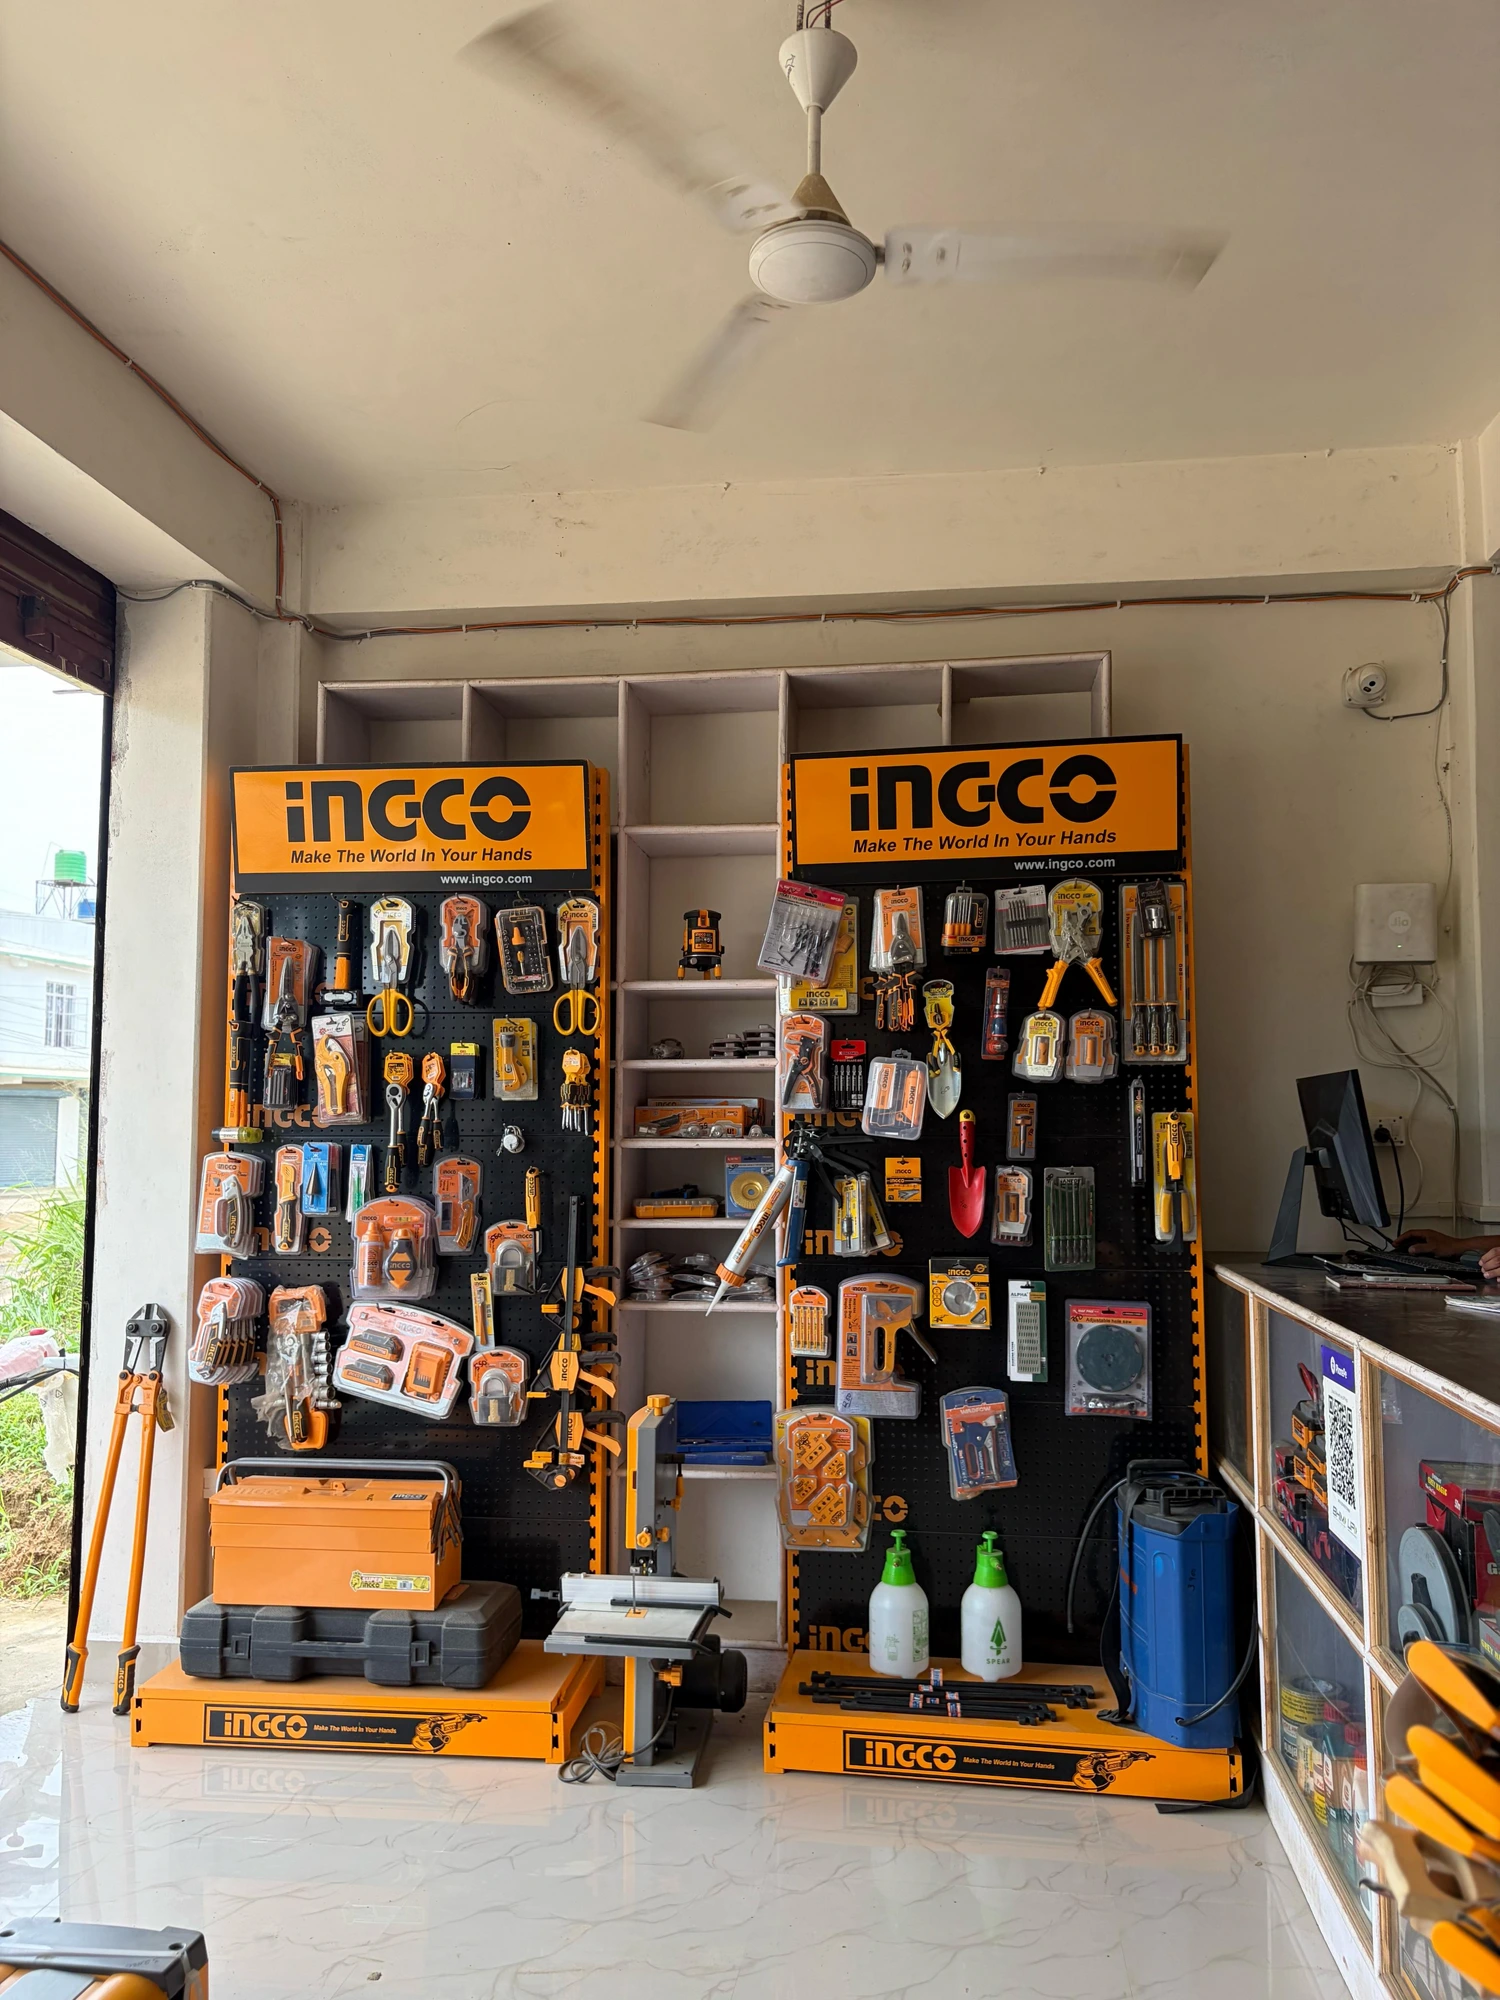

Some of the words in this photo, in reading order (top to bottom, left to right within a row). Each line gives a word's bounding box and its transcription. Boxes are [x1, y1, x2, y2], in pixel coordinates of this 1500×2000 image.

[850, 754, 1117, 831] INGCO
[286, 776, 531, 842] INGCO
[853, 838, 897, 853] Make
[902, 837, 933, 851] The
[938, 834, 989, 850] World
[993, 833, 1010, 848] In
[1015, 831, 1056, 847] Your
[1060, 829, 1117, 845] Hands
[290, 850, 331, 863] Make
[336, 849, 365, 863] The
[370, 848, 416, 862] World
[421, 848, 436, 862] In
[441, 848, 477, 861] Your
[481, 847, 533, 861] Hands
[1013, 858, 1116, 873] www.ingco.com
[440, 873, 533, 886] www.ingco.com
[986, 1657, 1011, 1665] SPEAR
[224, 1712, 308, 1739] INGCO
[865, 1740, 957, 1771] INGCO
[962, 1756, 979, 1764] Make
[993, 1758, 1012, 1766] World
[1034, 1762, 1055, 1770] Hands
